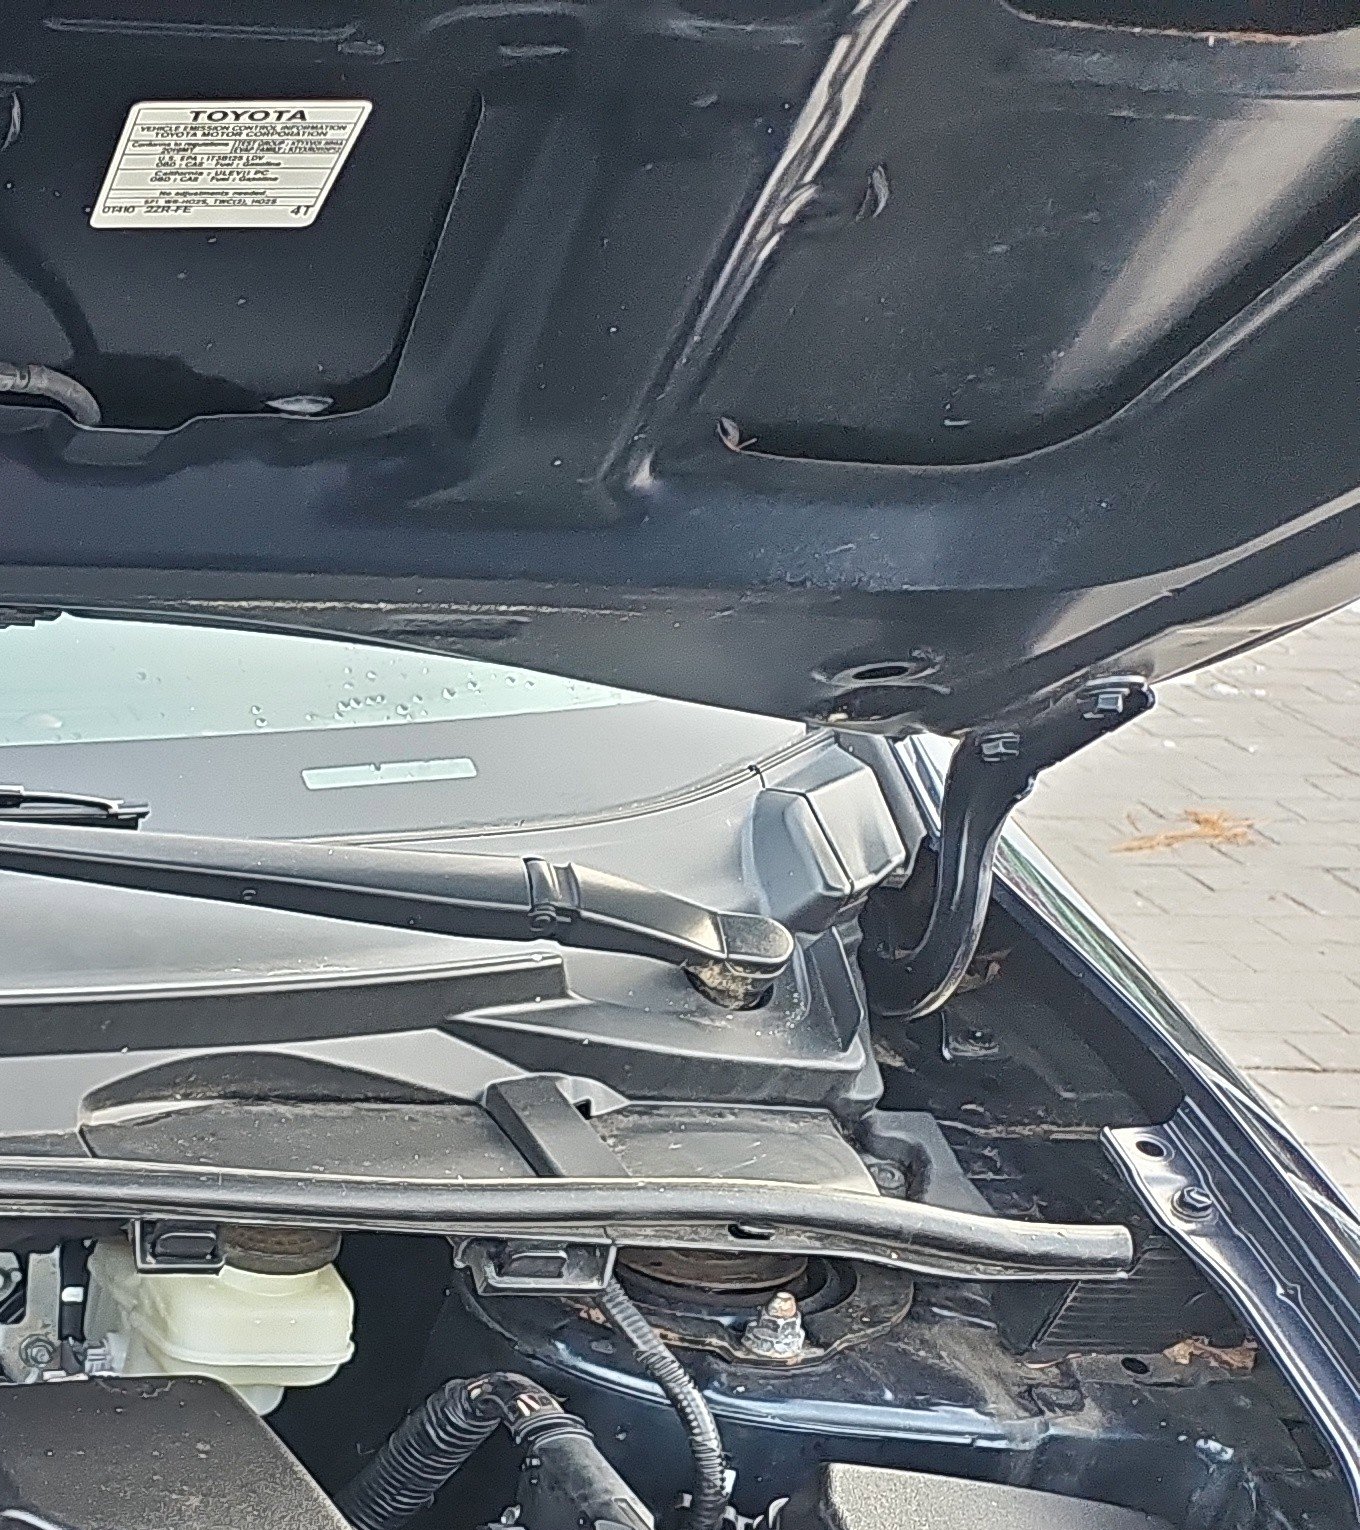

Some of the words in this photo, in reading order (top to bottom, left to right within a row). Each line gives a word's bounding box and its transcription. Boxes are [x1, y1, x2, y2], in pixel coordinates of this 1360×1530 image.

[190, 110, 307, 122] TOYOTA
[144, 206, 191, 214] 2ZR-FE
[291, 206, 313, 216] 4T
